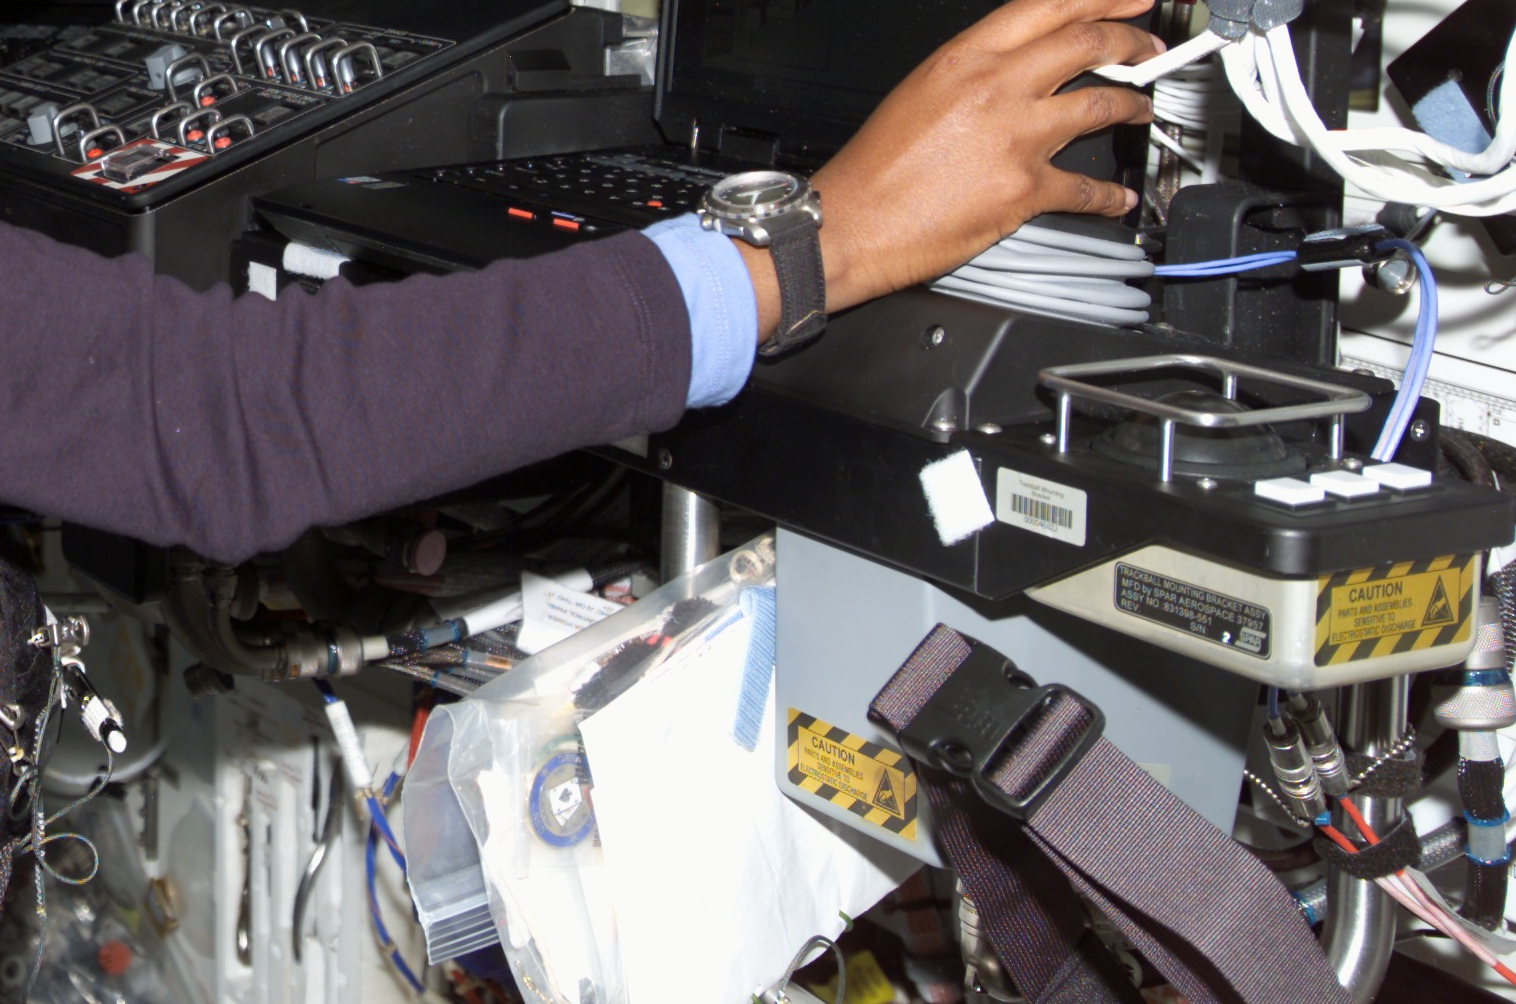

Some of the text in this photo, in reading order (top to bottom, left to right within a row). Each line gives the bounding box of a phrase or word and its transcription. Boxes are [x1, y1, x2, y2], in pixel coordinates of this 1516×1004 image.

[1120, 565, 1265, 620] TRACKBALL MOUNTING BRACKET ASSY
[1121, 588, 1142, 602] ASSY
[1122, 577, 1139, 591] MFD
[1153, 587, 1176, 604] SPAR
[1179, 595, 1234, 623] AEROSPACE
[1349, 580, 1402, 603] CAUTION
[1338, 597, 1411, 618] PARTS AND ASSEMBLIES
[1355, 611, 1394, 627] SENSITIVE TO
[1222, 630, 1230, 644] 2
[1240, 632, 1260, 646] SPAR
[1332, 619, 1415, 642] ELECTROSTATIC DISCHARGE
[812, 735, 854, 765] CAUTION
[804, 746, 862, 781] PARTS AND ASSEMBLIES
[817, 761, 849, 784] SENSITIVE TO
[800, 762, 867, 800] ELECTROSTATIC DISCHARGE
